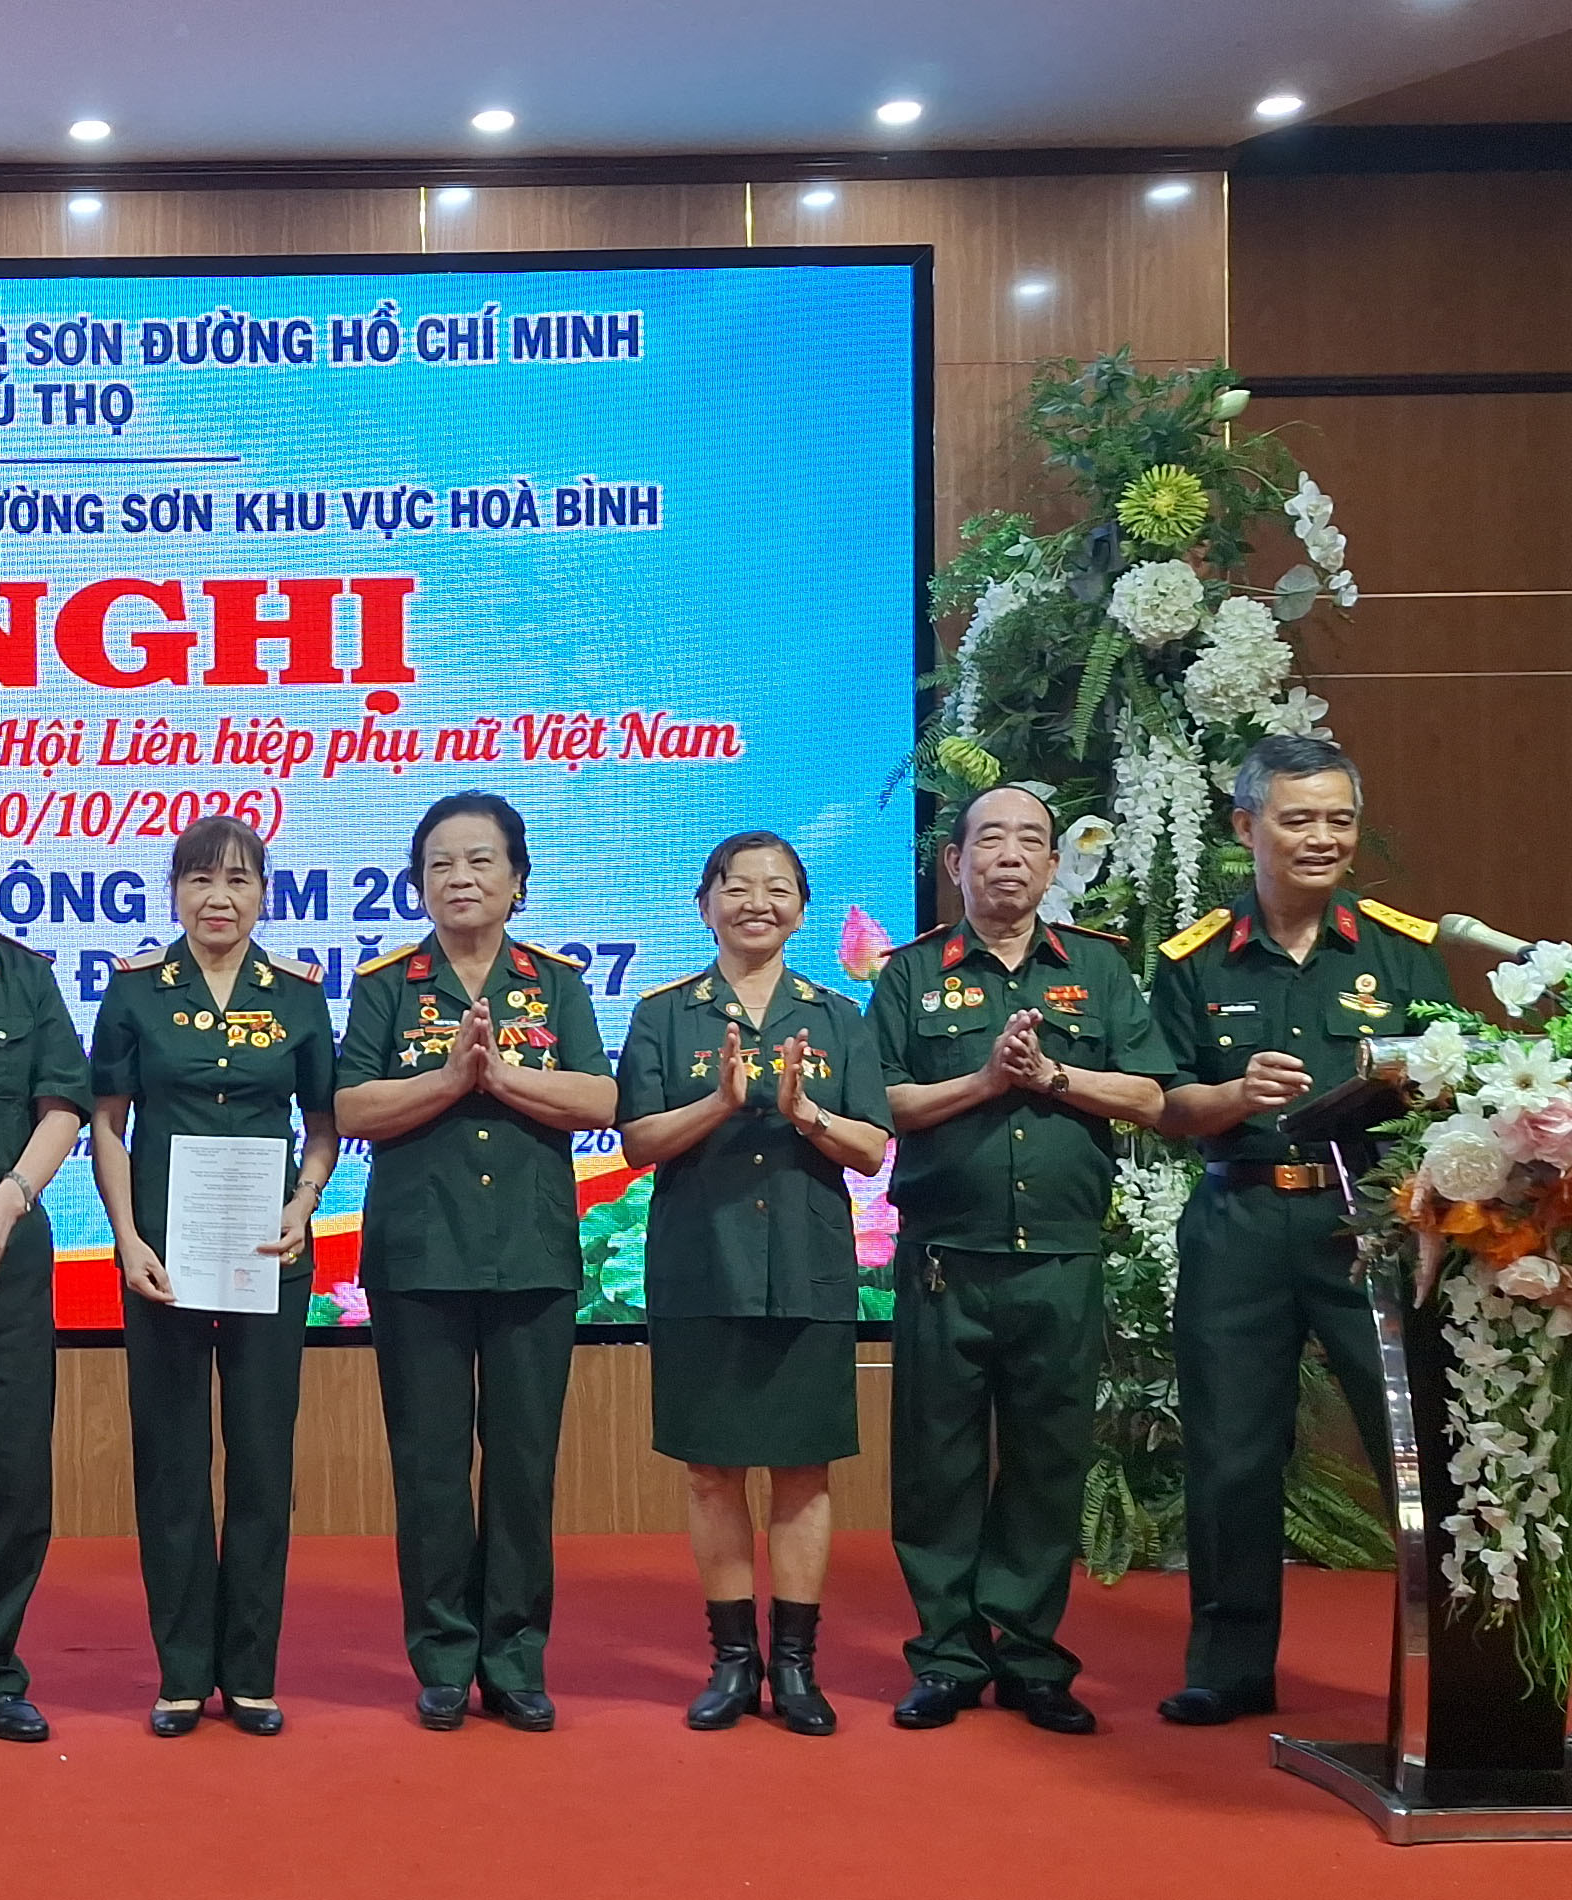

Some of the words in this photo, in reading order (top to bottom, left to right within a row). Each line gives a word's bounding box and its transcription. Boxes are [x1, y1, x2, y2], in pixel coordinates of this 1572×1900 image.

[25, 315, 123, 367] SƠN
[140, 309, 313, 366] ĐƯỜNG
[332, 301, 400, 363] HỒ
[416, 305, 496, 362] CHÍ
[513, 314, 640, 360] MINH
[32, 383, 134, 436] THỌ
[120, 488, 213, 534] SƠN
[235, 491, 326, 533] KHU
[342, 484, 434, 540] VỰC
[451, 479, 541, 530] HOÀ
[555, 478, 659, 527] BÌNH
[97, 717, 203, 766] Liên
[213, 716, 315, 779] hiệp
[322, 714, 423, 779] phụ
[435, 717, 502, 762] nữ
[513, 711, 608, 771] Việt
[619, 710, 741, 759] Nam
